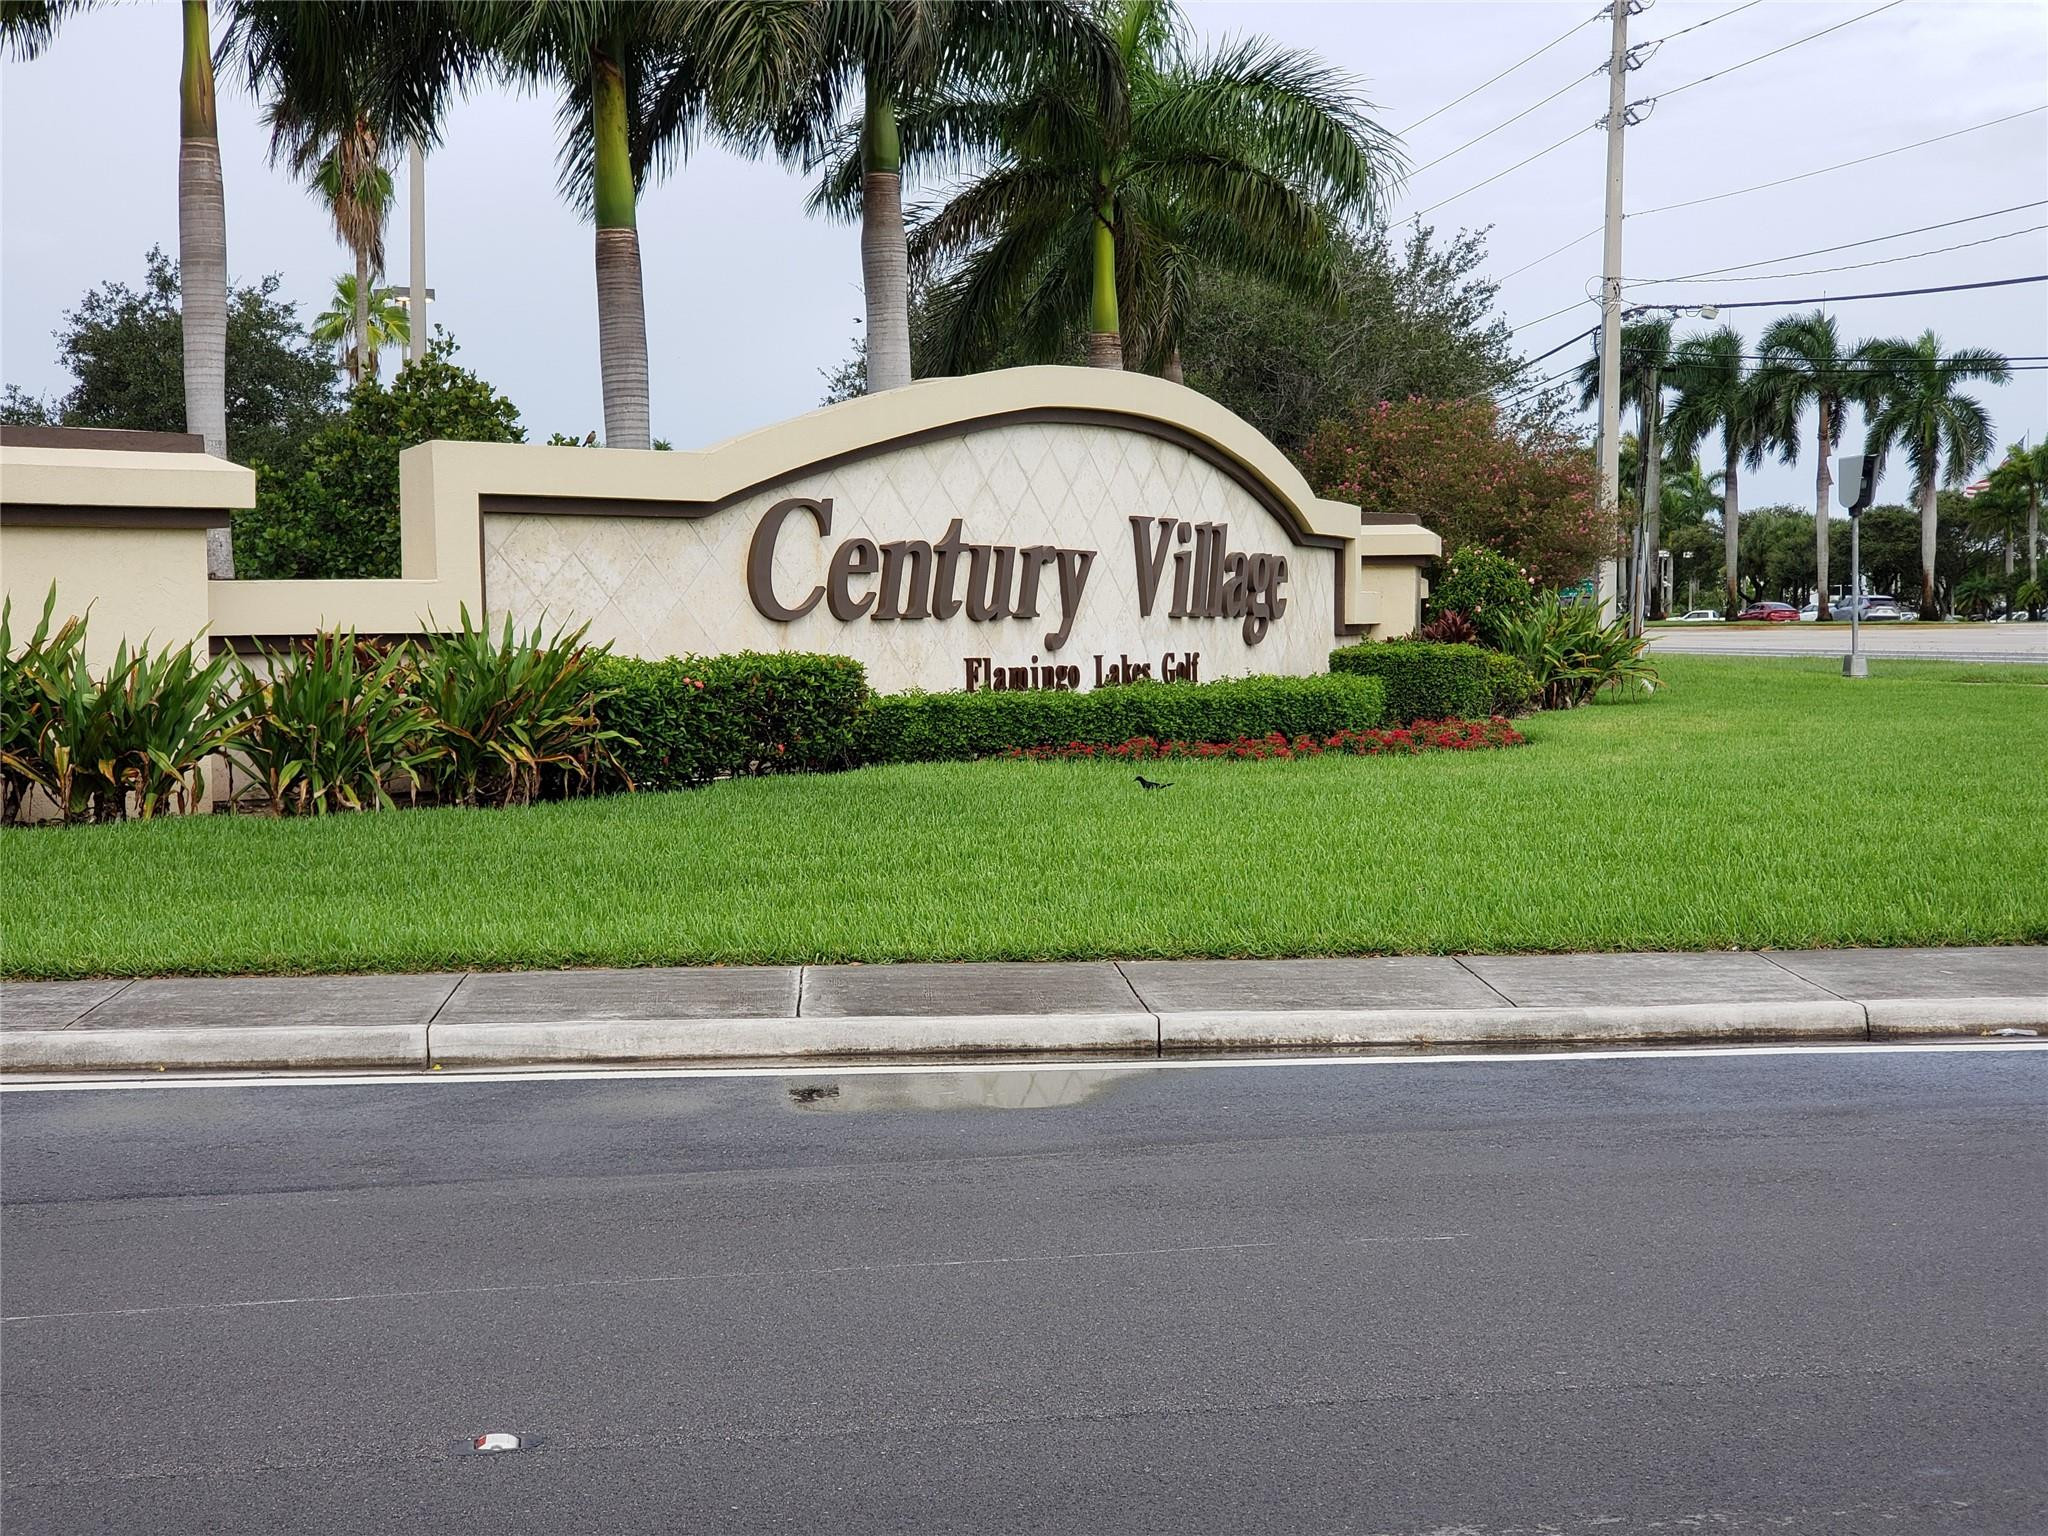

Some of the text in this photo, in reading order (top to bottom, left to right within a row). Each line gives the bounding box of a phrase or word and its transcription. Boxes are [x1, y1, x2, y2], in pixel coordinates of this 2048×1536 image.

[747, 498, 1288, 650] Century Village
[963, 652, 1200, 693] Flamingo Lakes Golf
